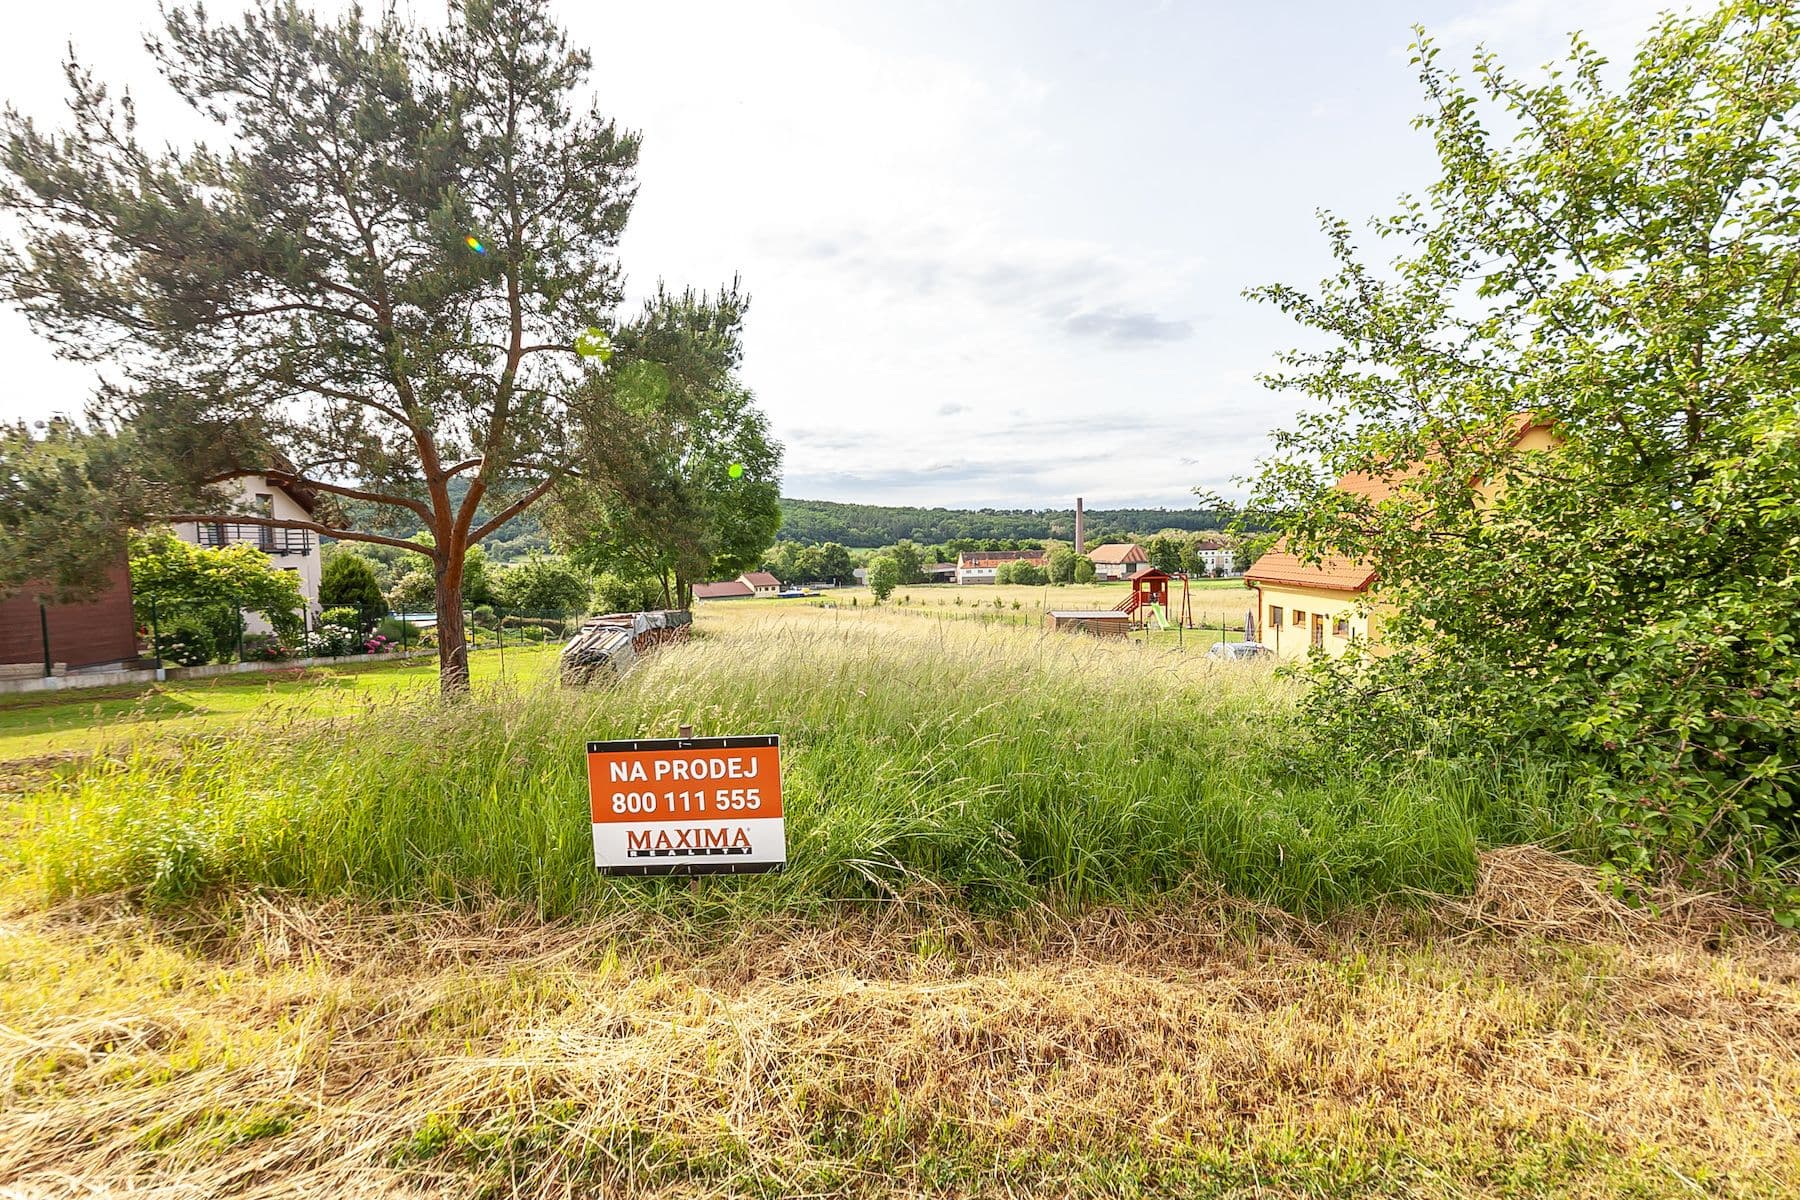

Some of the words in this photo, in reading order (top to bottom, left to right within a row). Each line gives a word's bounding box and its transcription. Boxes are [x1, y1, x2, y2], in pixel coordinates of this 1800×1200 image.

[609, 761, 648, 783] NA
[654, 757, 759, 781] PRODEJ
[611, 792, 657, 814] 800
[664, 790, 706, 812] 111
[715, 788, 761, 811] 555
[626, 827, 751, 849] MAXIMA
